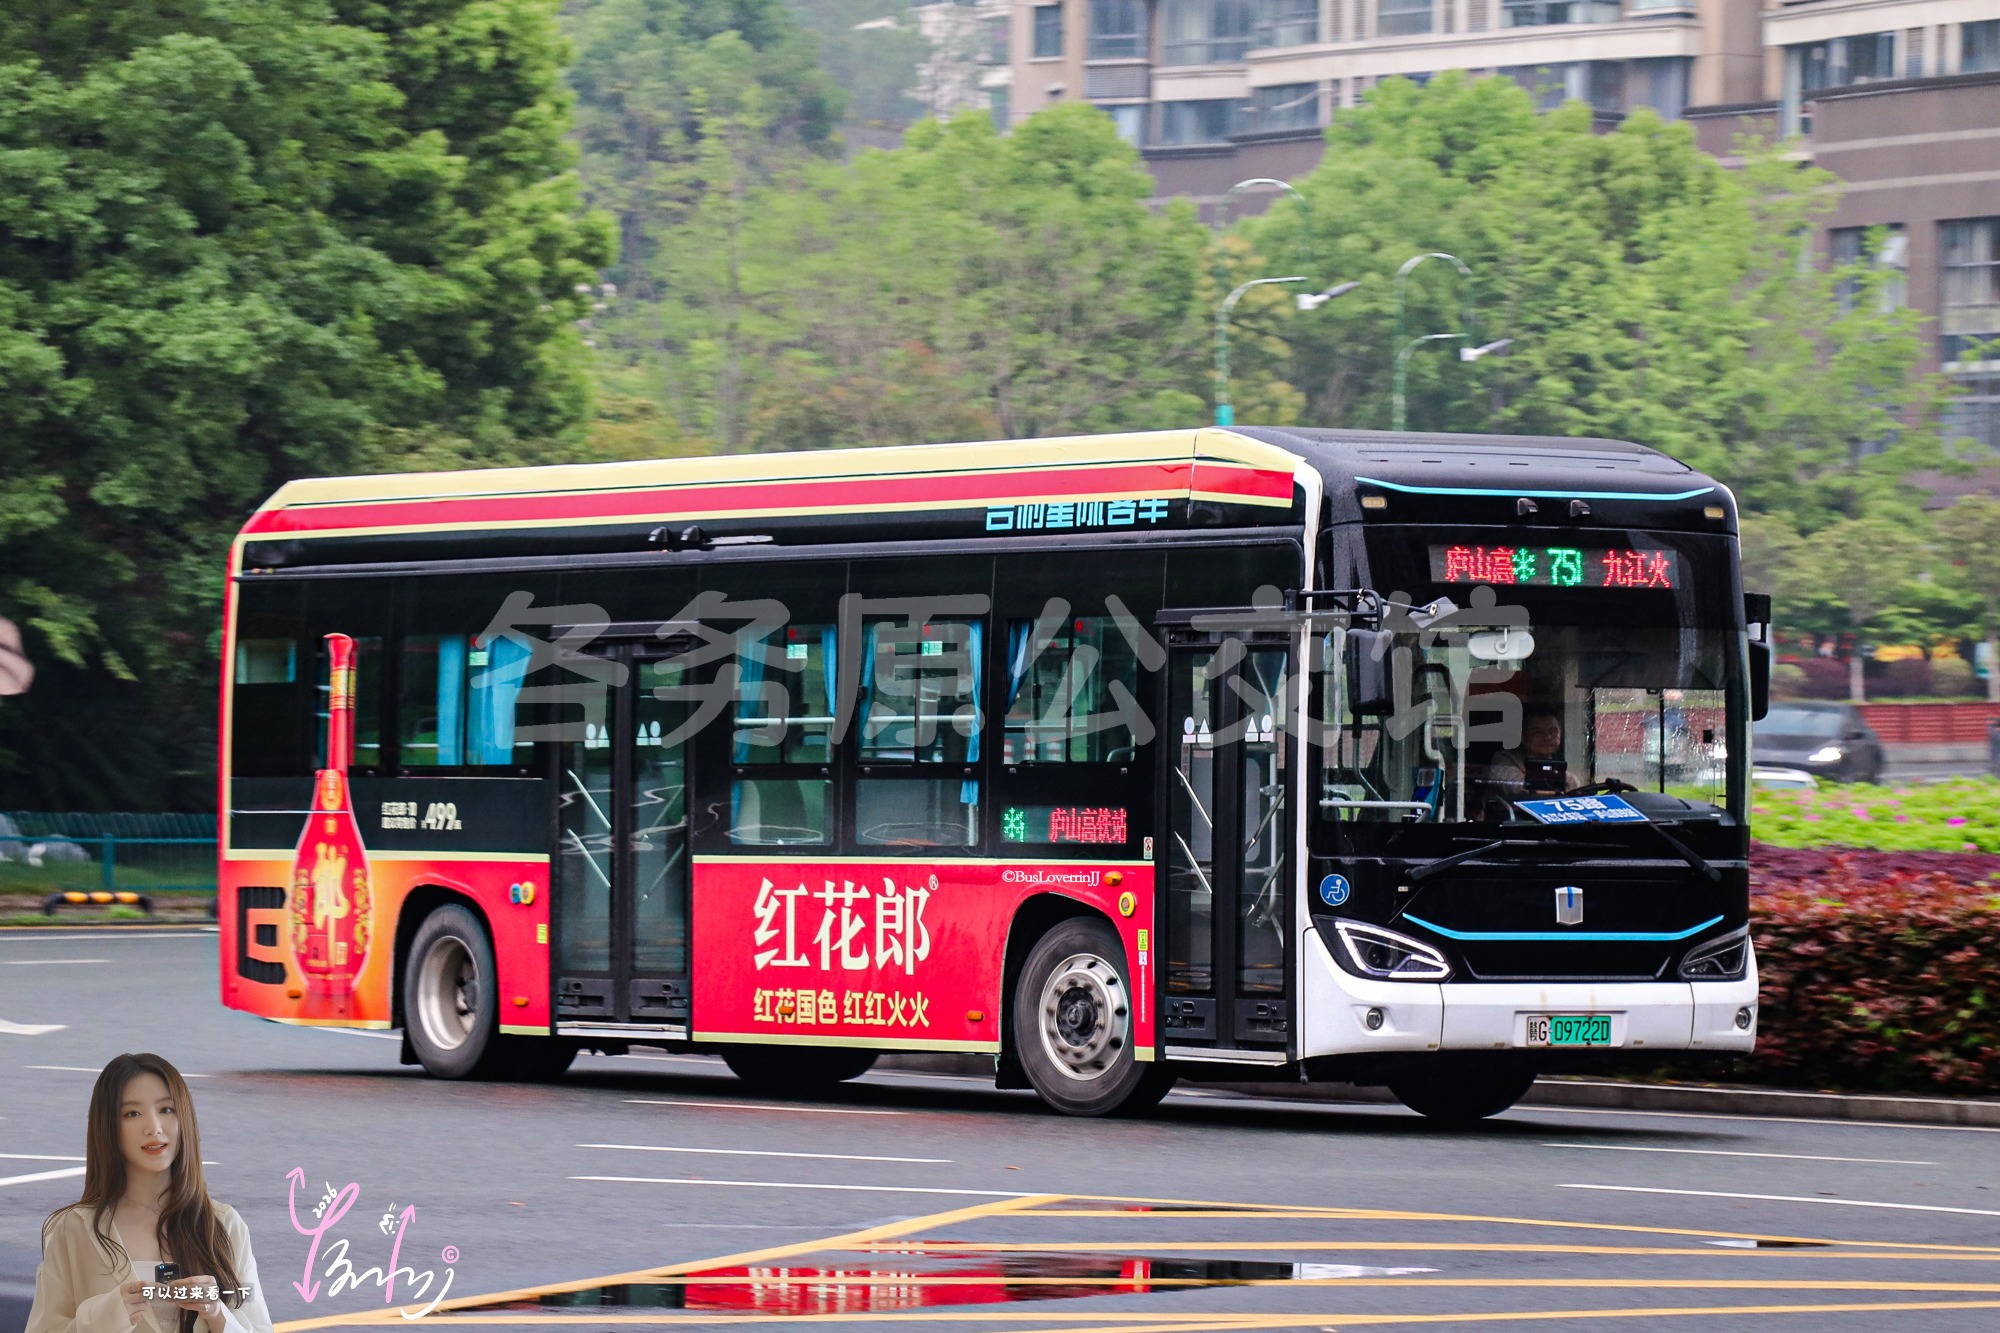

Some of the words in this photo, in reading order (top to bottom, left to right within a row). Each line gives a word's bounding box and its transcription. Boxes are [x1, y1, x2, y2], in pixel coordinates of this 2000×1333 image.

[1602, 550, 1671, 588] 九江火
[753, 987, 838, 1025] 红花国色
[843, 989, 930, 1028] 红红火火
